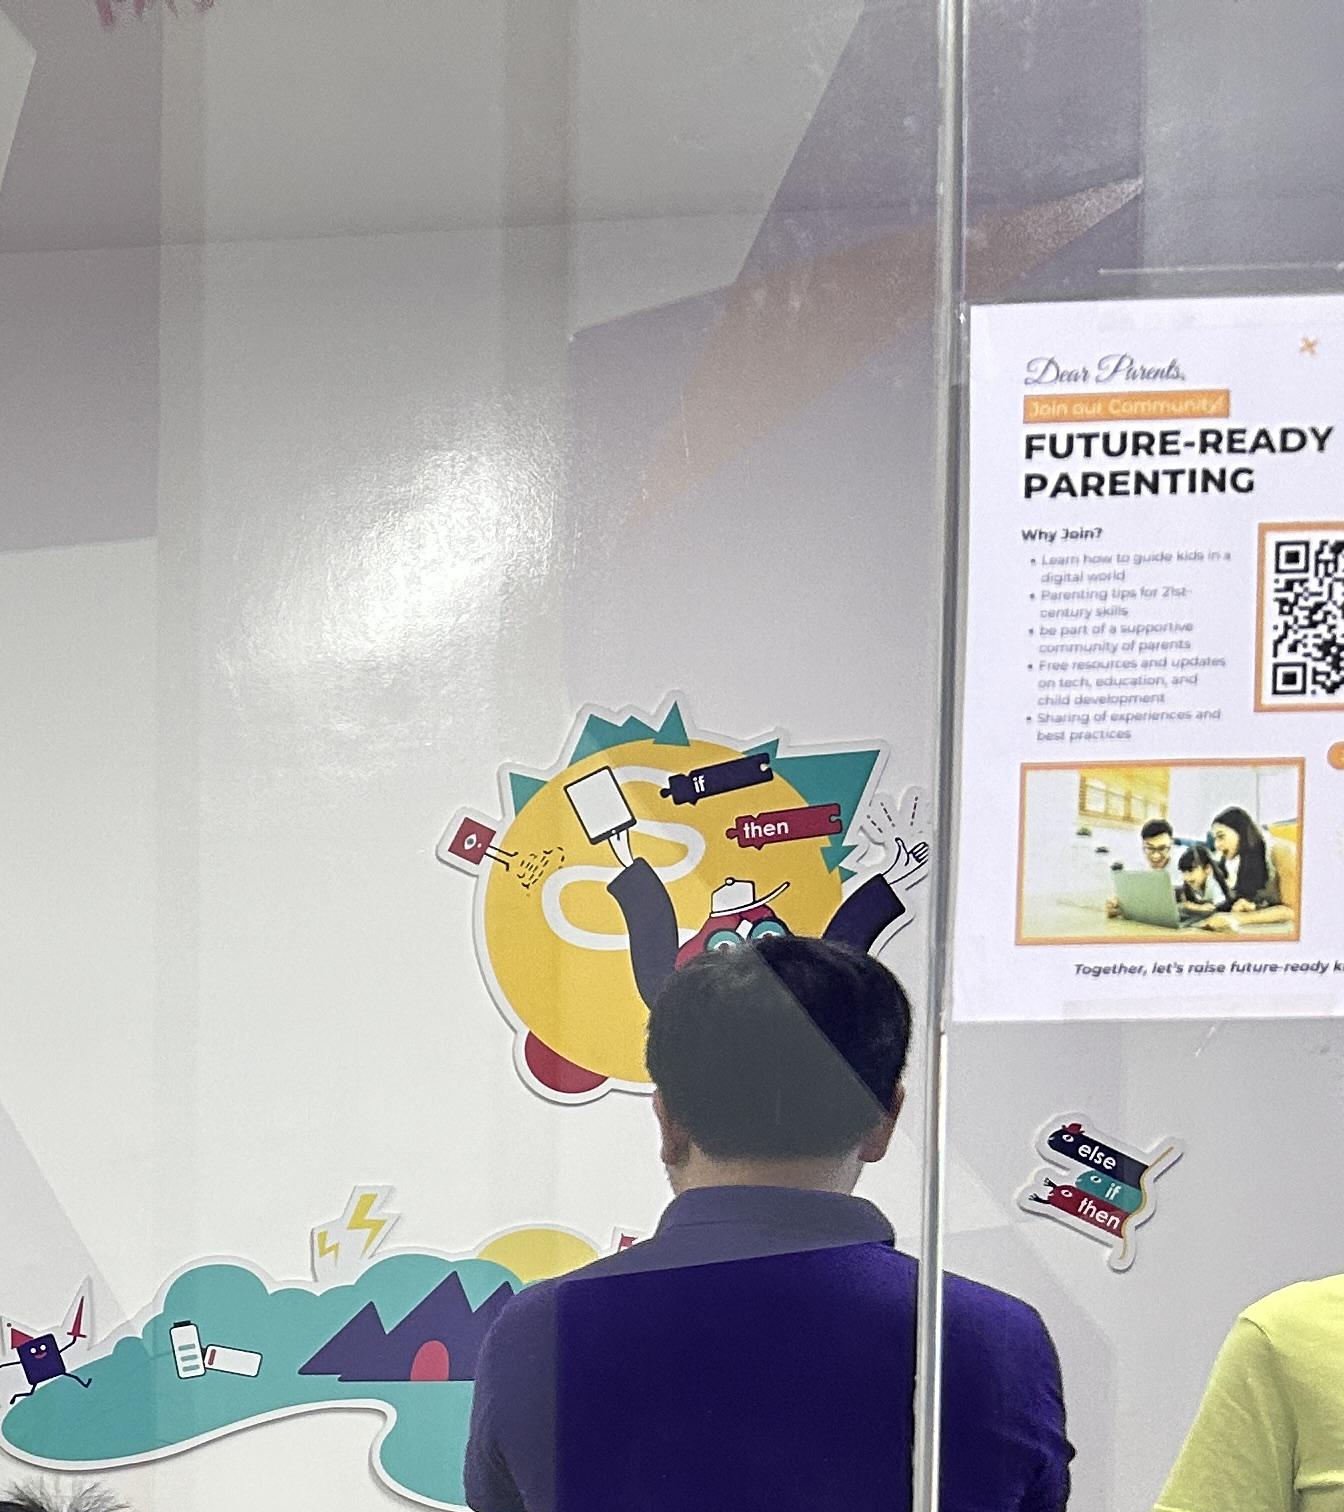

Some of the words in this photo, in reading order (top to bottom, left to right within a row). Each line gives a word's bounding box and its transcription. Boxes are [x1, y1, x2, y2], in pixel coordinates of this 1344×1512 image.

[1023, 356, 1090, 385] Dear
[1030, 402, 1068, 416] Join
[1073, 403, 1102, 415] our
[1025, 426, 1334, 460] FUTURE-READY
[1024, 467, 1254, 499] PARENTING
[1022, 529, 1056, 542] Why
[1062, 528, 1103, 540] Join?
[1042, 555, 1079, 565] Learn
[1083, 554, 1112, 564] how
[1116, 553, 1130, 564] to
[1134, 552, 1173, 565] guide
[1176, 550, 1204, 561] kids
[1208, 550, 1220, 560] in
[1223, 552, 1231, 560] a
[1041, 572, 1083, 585] digital
[1088, 571, 1125, 582] world
[1041, 590, 1107, 602] Parenting
[1112, 588, 1136, 600] tips
[1140, 587, 1158, 598] for
[1040, 607, 1092, 619] century
[1096, 605, 1128, 617] skills
[1040, 625, 1056, 636] be
[1060, 624, 1088, 638] part
[1092, 622, 1105, 634] of
[1109, 625, 1116, 634] a
[1120, 622, 1193, 635] supportive
[1039, 641, 1117, 654] community
[1122, 640, 1135, 651] of
[1139, 639, 1191, 652] parents
[1039, 660, 1068, 671] Free
[1072, 659, 1138, 670] resources
[1141, 657, 1167, 668] and
[1171, 656, 1226, 669] updates
[1038, 695, 1069, 706] child
[1074, 693, 1165, 707] development
[1037, 712, 1089, 725] Sharing
[1094, 711, 1107, 722] of
[1110, 710, 1192, 723] experiences
[1195, 709, 1220, 720] and
[1037, 730, 1065, 741] best
[1069, 728, 1131, 744] practices
[693, 775, 706, 794] if
[743, 817, 789, 839] then
[1075, 963, 1147, 977] Together,
[1152, 962, 1183, 974] let's
[1188, 962, 1225, 974] raise
[1230, 960, 1329, 975] future-ready
[1078, 1144, 1116, 1170] else
[1105, 1183, 1121, 1201] if
[1078, 1197, 1121, 1230] then
